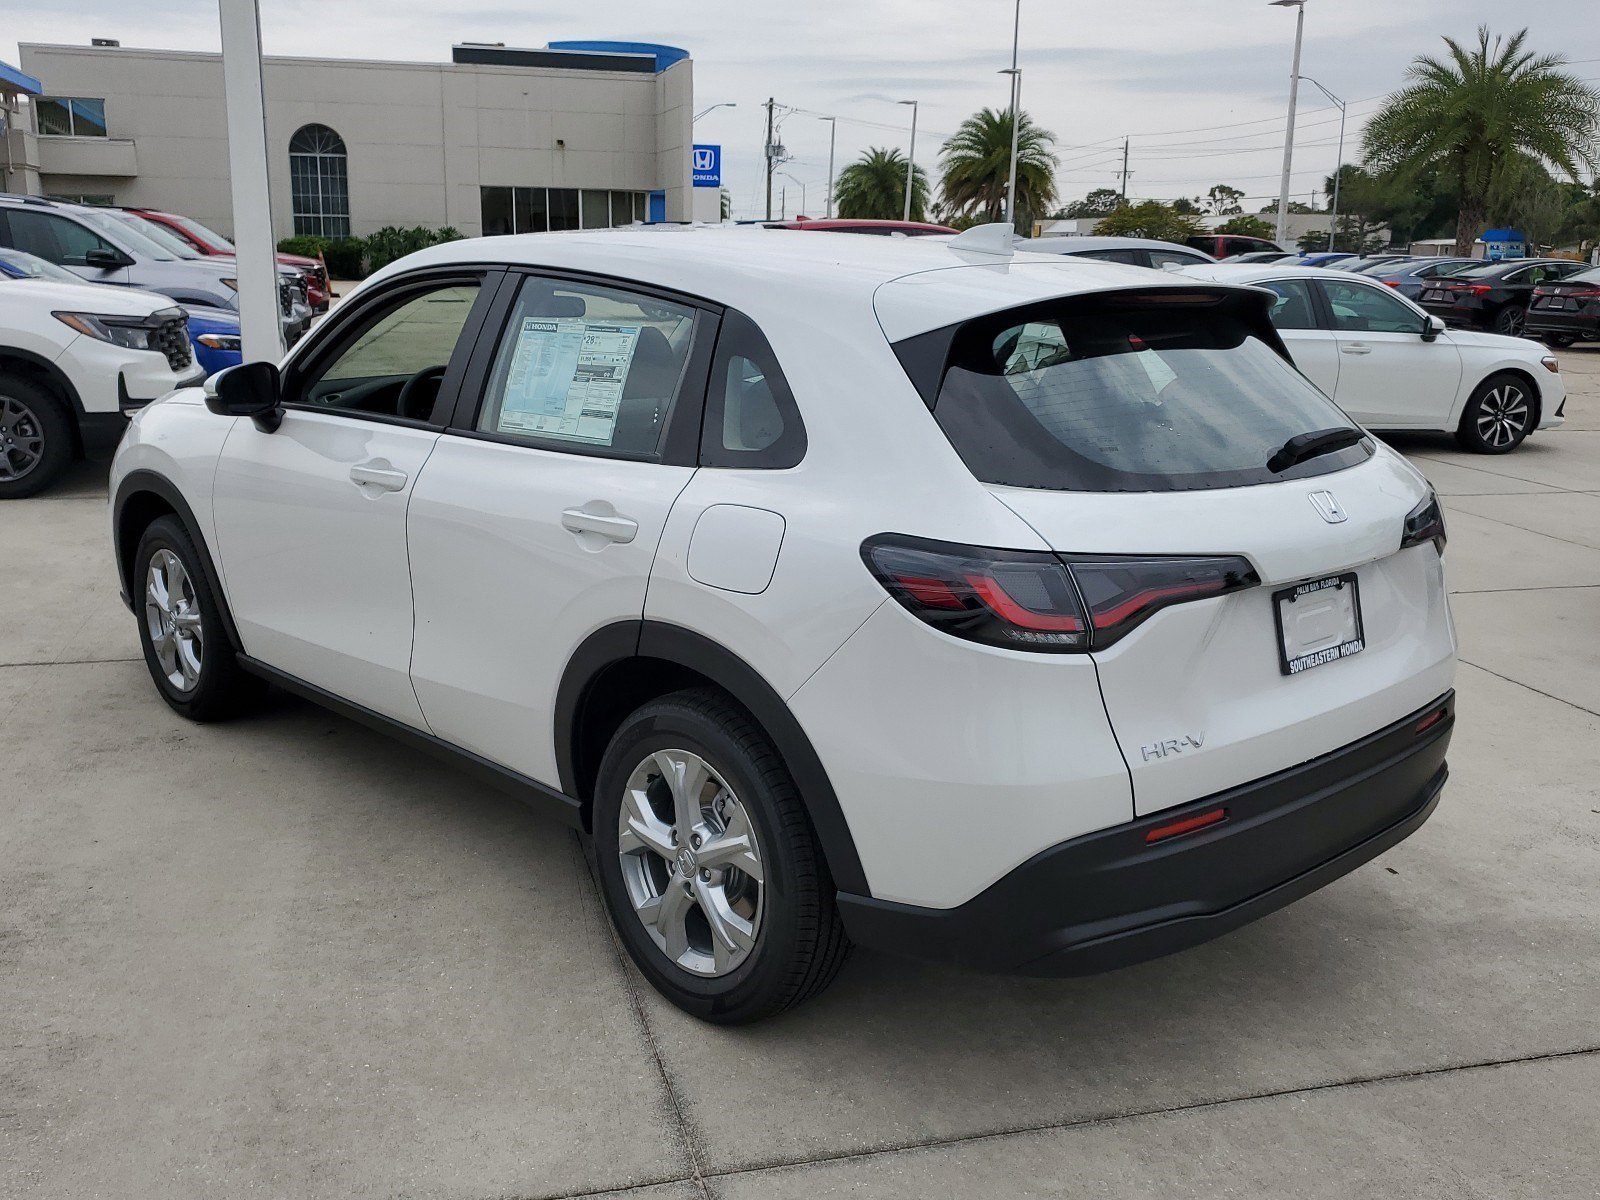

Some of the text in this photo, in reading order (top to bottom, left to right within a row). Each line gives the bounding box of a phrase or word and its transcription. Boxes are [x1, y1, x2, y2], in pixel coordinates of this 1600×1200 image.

[531, 323, 557, 331] HONDA
[1296, 584, 1310, 596] PALM
[1320, 576, 1340, 589] FLORIDA
[1289, 639, 1364, 675] SOUTHEASTERN HONDA
[1140, 729, 1206, 762] HR-V
